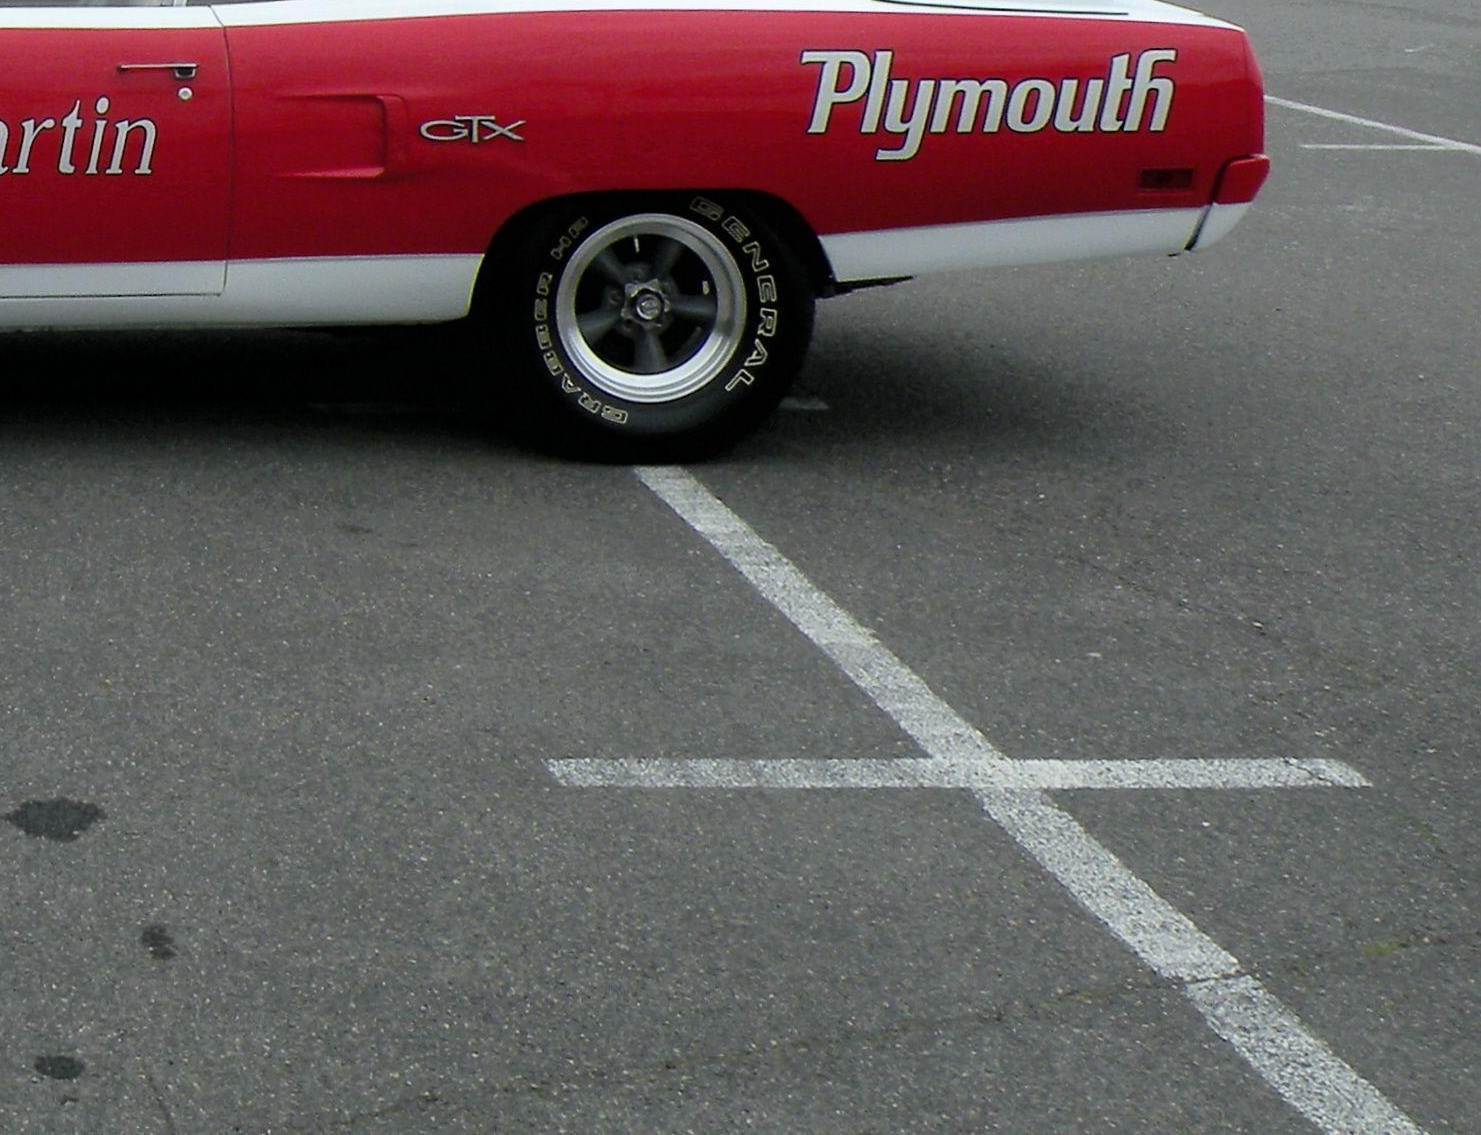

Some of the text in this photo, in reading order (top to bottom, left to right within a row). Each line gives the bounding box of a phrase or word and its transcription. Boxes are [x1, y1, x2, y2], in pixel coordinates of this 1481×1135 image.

[420, 115, 527, 143] GTX
[801, 49, 1178, 161] Plymouth
[533, 271, 629, 424] GRABBER
[689, 196, 778, 392] GENERAL
